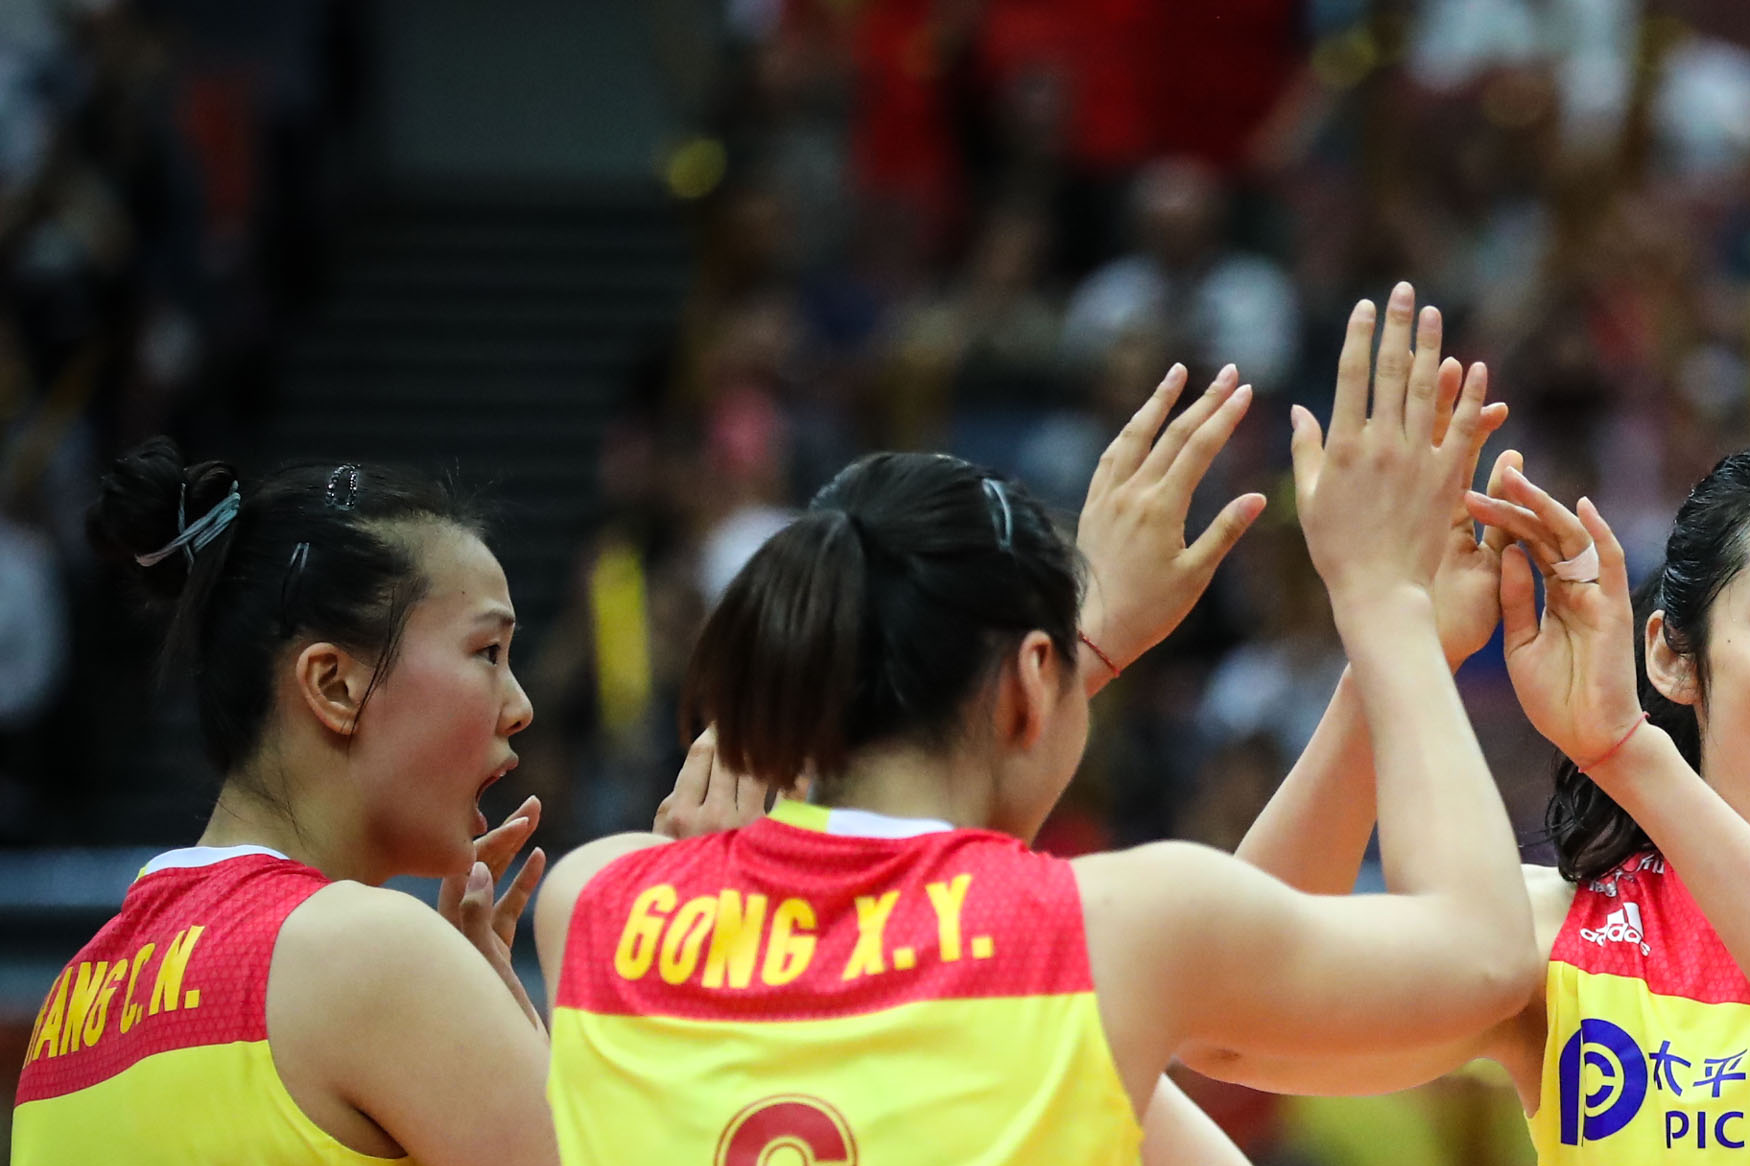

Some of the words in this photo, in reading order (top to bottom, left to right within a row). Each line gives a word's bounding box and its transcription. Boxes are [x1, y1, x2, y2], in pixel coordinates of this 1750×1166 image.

[614, 883, 818, 989] GONG
[1580, 922, 1653, 957] addas
[23, 960, 128, 1069] ANG
[1665, 1110, 1745, 1149] PIC
